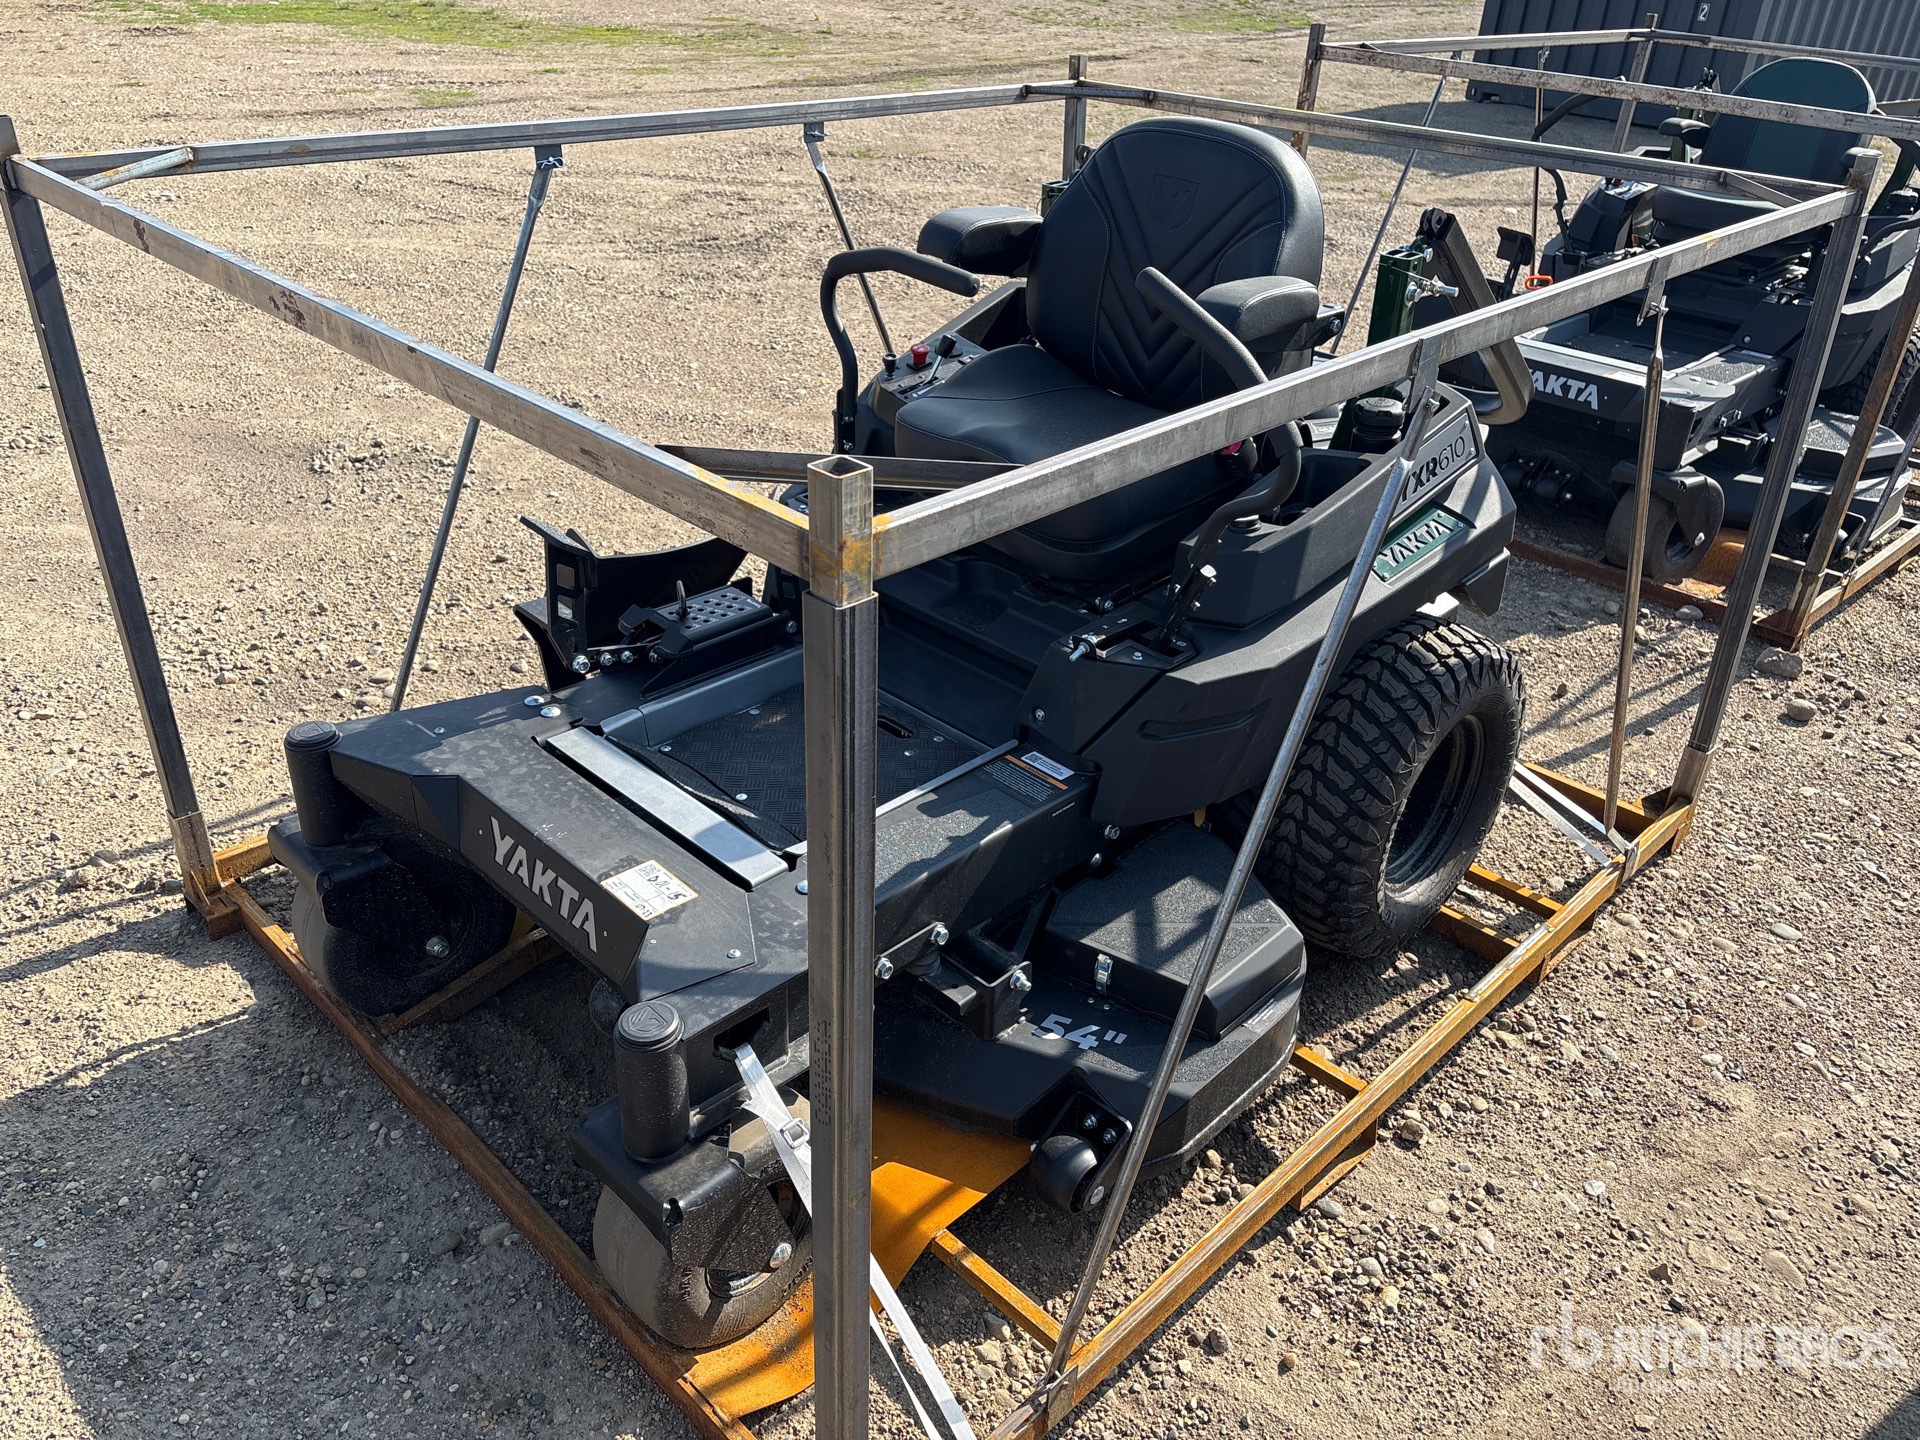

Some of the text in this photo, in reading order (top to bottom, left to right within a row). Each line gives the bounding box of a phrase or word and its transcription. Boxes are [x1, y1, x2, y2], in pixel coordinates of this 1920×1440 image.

[1699, 5, 1708, 20] 2
[1529, 368, 1599, 411] AKTA
[1379, 519, 1454, 567] YAKTA
[490, 815, 597, 954] YAKTA
[1032, 1013, 1128, 1050] 54"
